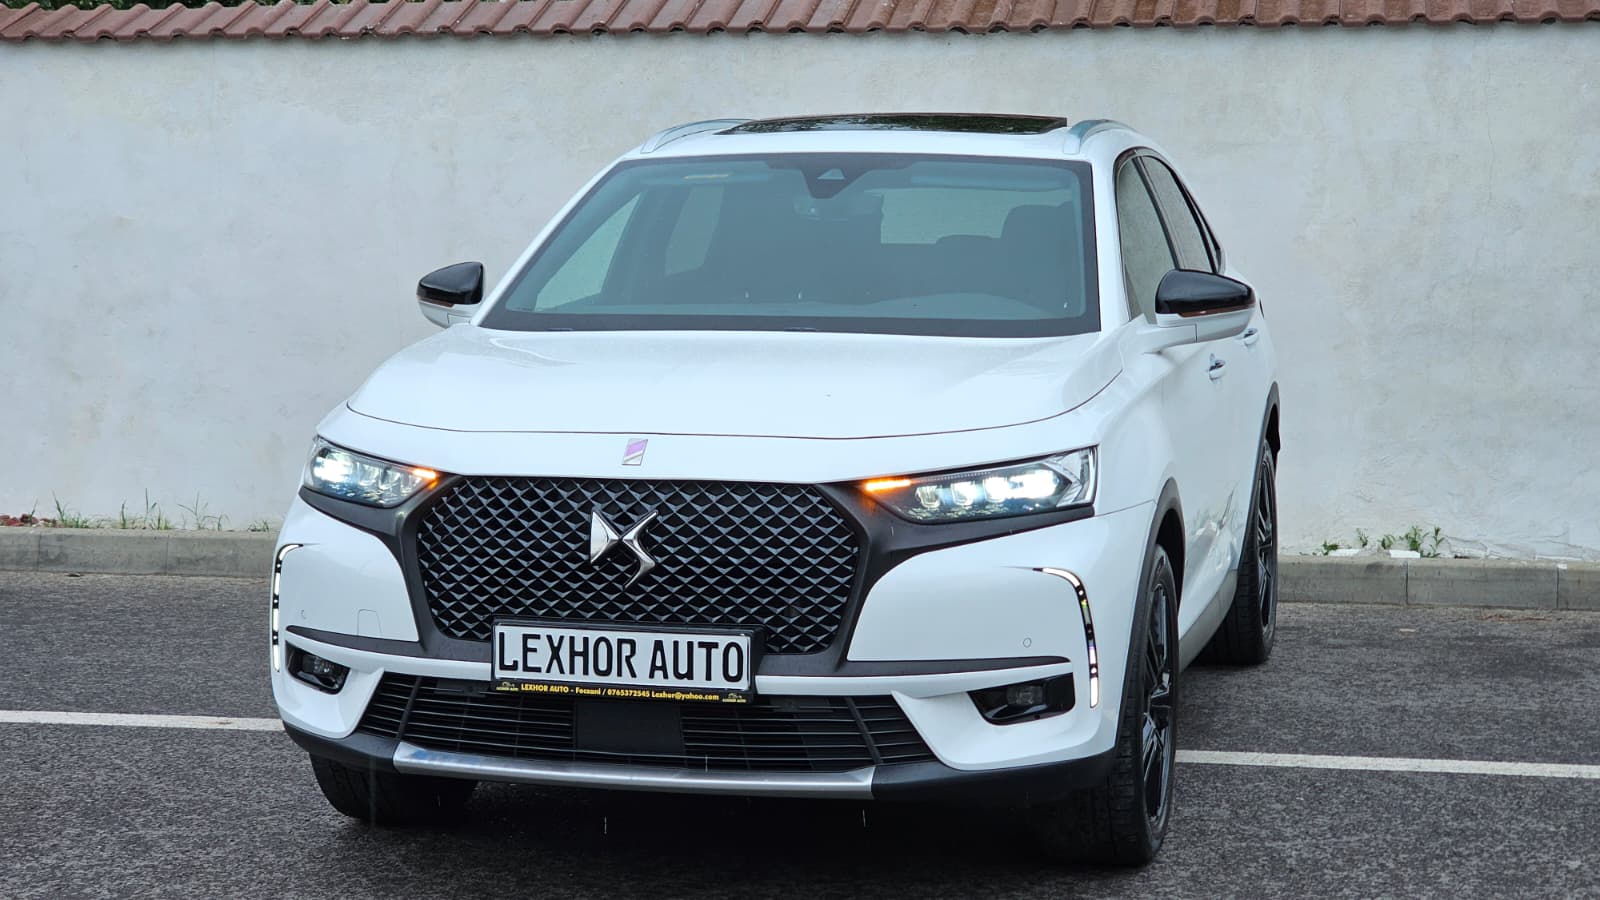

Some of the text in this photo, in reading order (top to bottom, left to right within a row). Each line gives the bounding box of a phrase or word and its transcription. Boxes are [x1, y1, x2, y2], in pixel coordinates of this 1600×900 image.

[499, 632, 744, 683] LEXHOR AUTO
[521, 683, 548, 692] LEXHOR
